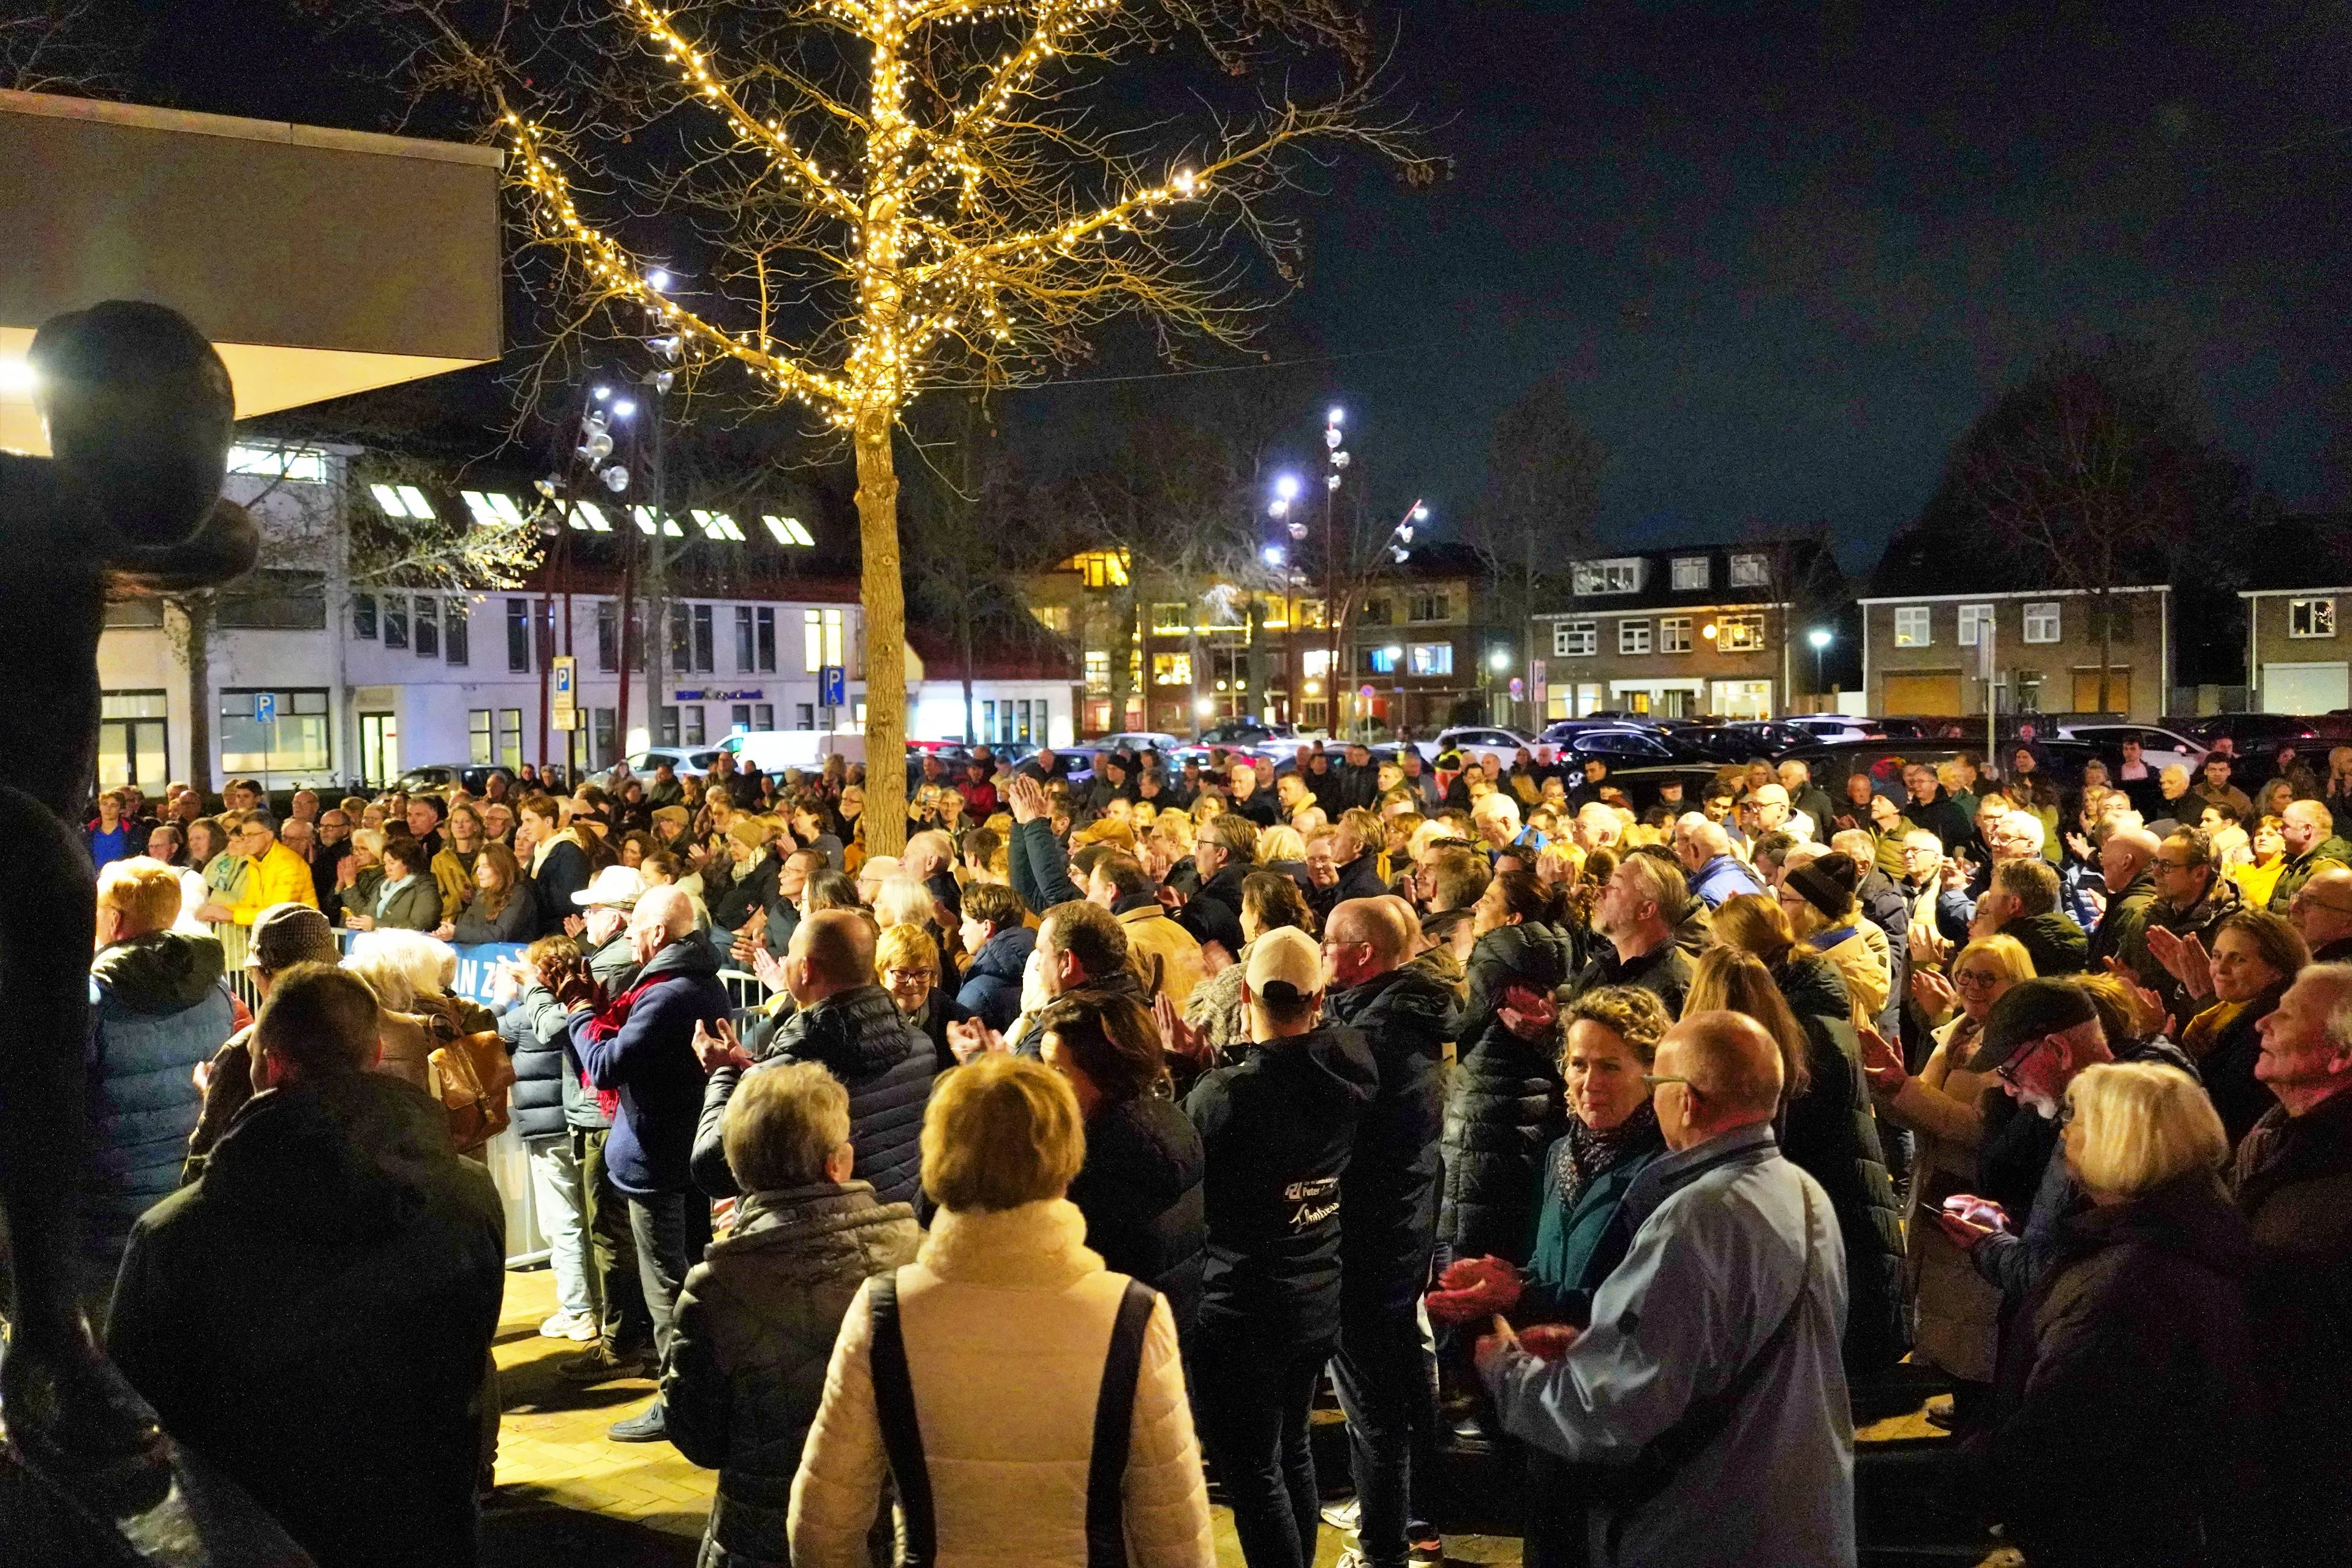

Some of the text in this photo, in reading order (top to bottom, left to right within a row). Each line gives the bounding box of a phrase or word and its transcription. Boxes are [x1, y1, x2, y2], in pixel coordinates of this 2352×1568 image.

[559, 669, 567, 690] P
[829, 670, 841, 690] P
[260, 696, 271, 711] P
